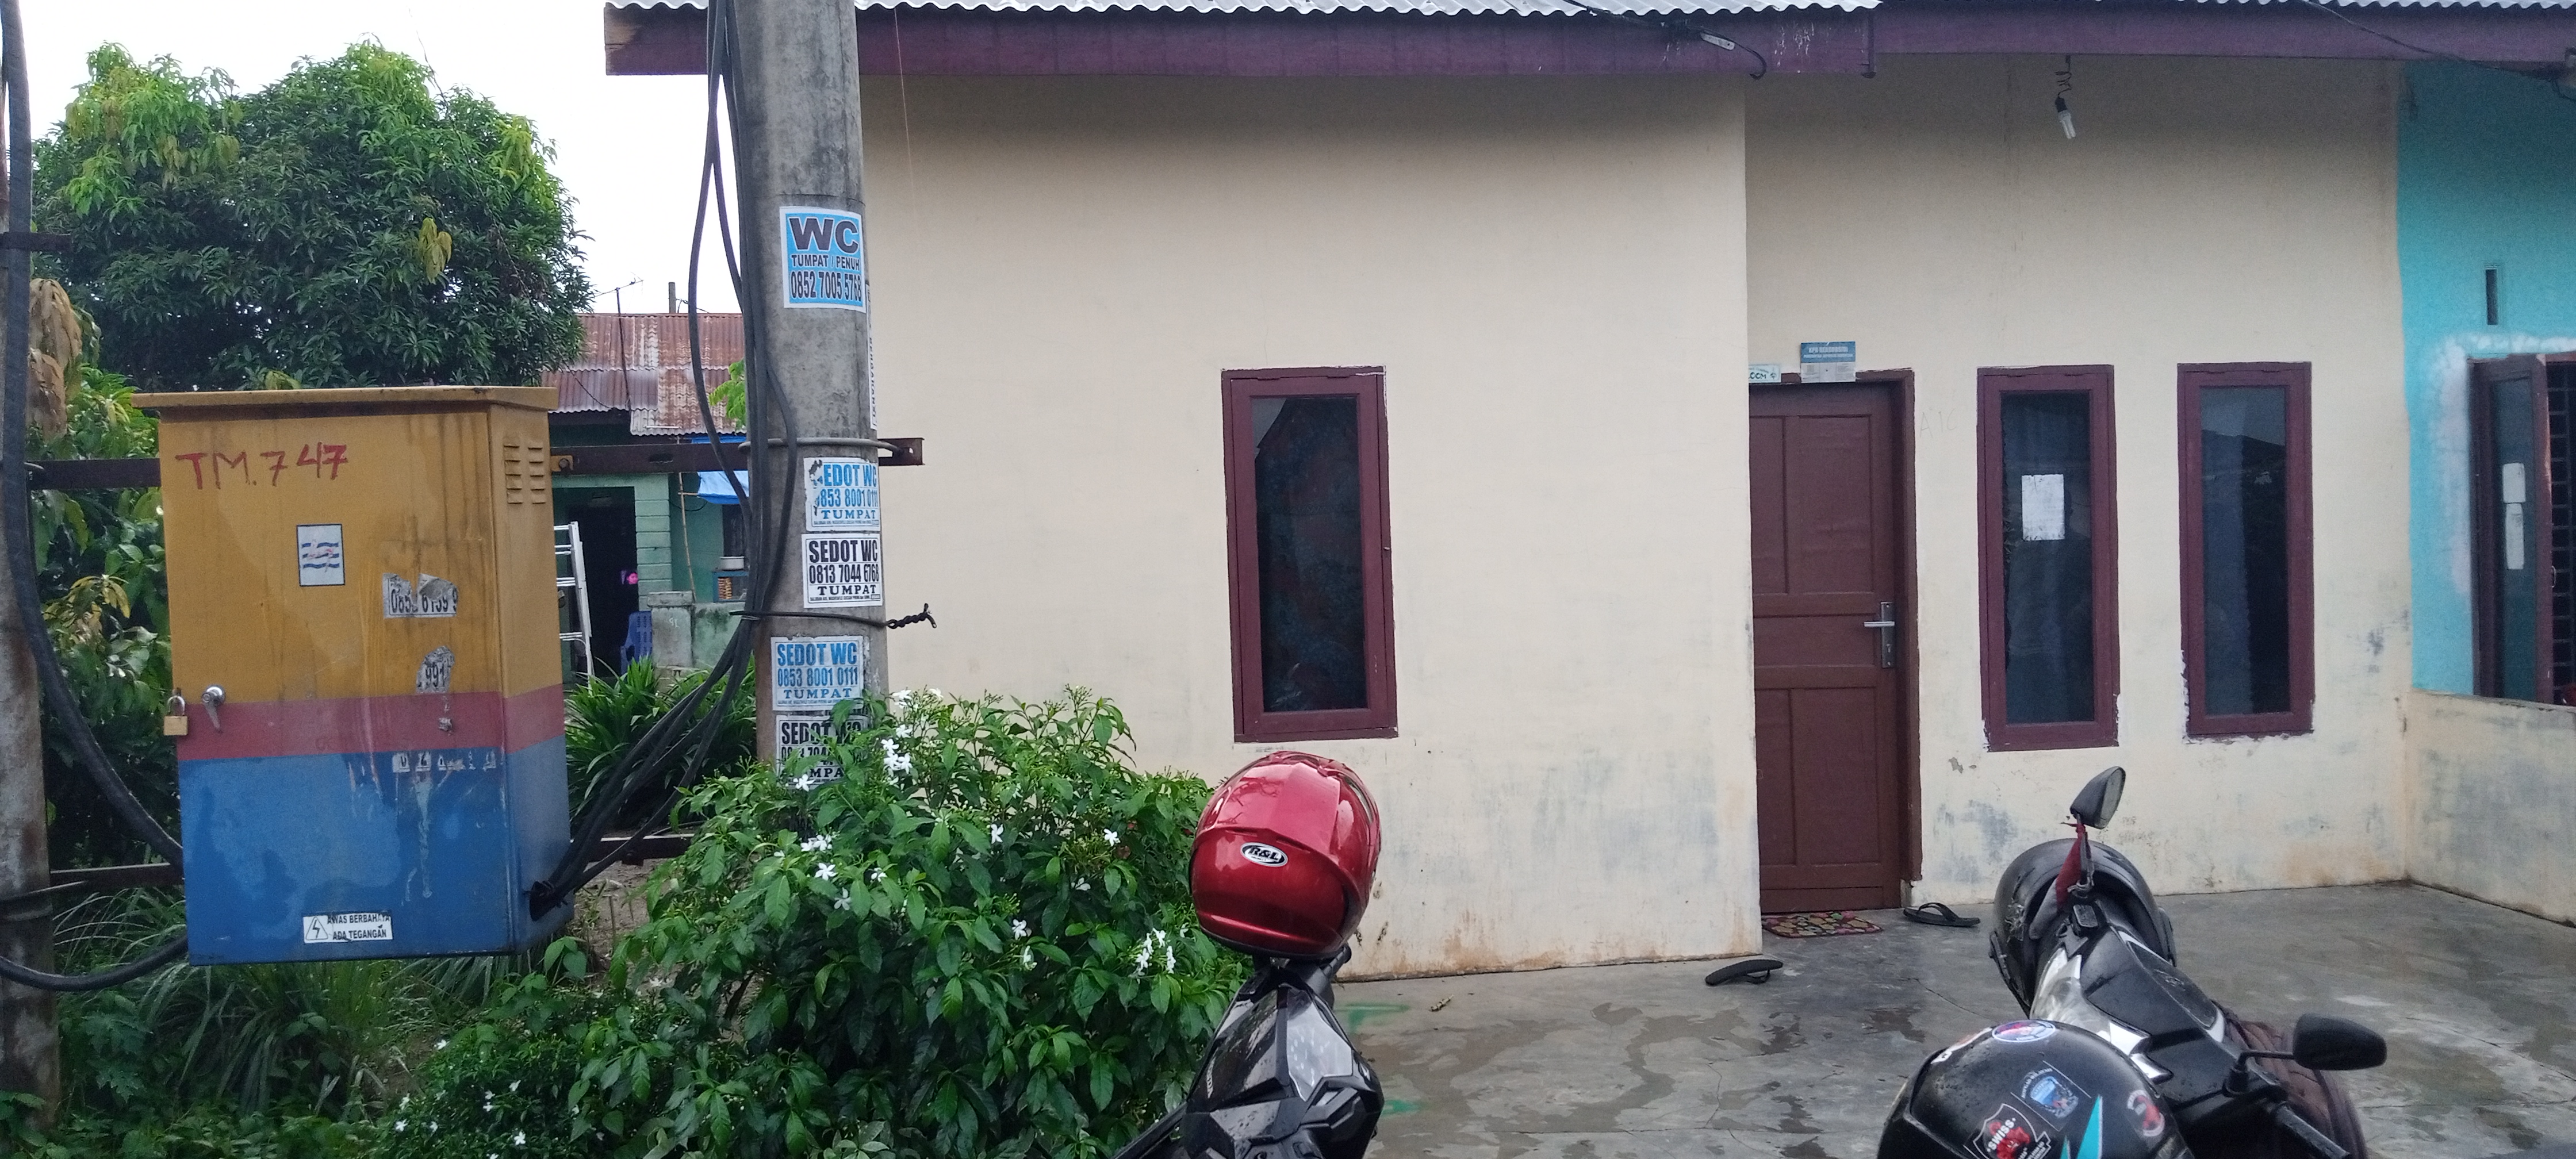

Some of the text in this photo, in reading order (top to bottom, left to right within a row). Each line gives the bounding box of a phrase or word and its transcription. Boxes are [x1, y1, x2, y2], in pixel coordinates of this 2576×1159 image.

[789, 217, 860, 254] WC
[791, 255, 828, 267] TUMPAT
[837, 256, 860, 271] PENUH
[791, 271, 862, 302] 0852 7005 5768
[814, 464, 877, 487] EDOT WC
[845, 489, 866, 507] 8001
[821, 509, 876, 519] TUMPAT
[809, 540, 877, 563] SEDOT WC
[809, 565, 835, 584] 0813
[839, 564, 861, 582] 7044
[817, 585, 876, 596] TUMPAT
[777, 642, 857, 666] SEDOT WC
[777, 667, 858, 687] 0853 8001 0111
[784, 688, 852, 699] TUMPAT
[781, 722, 831, 744] SEDOT
[1248, 847, 1279, 861] R&L
[333, 930, 387, 941] ADA TEGANGAN
[1988, 1119, 2014, 1150] SWISS
